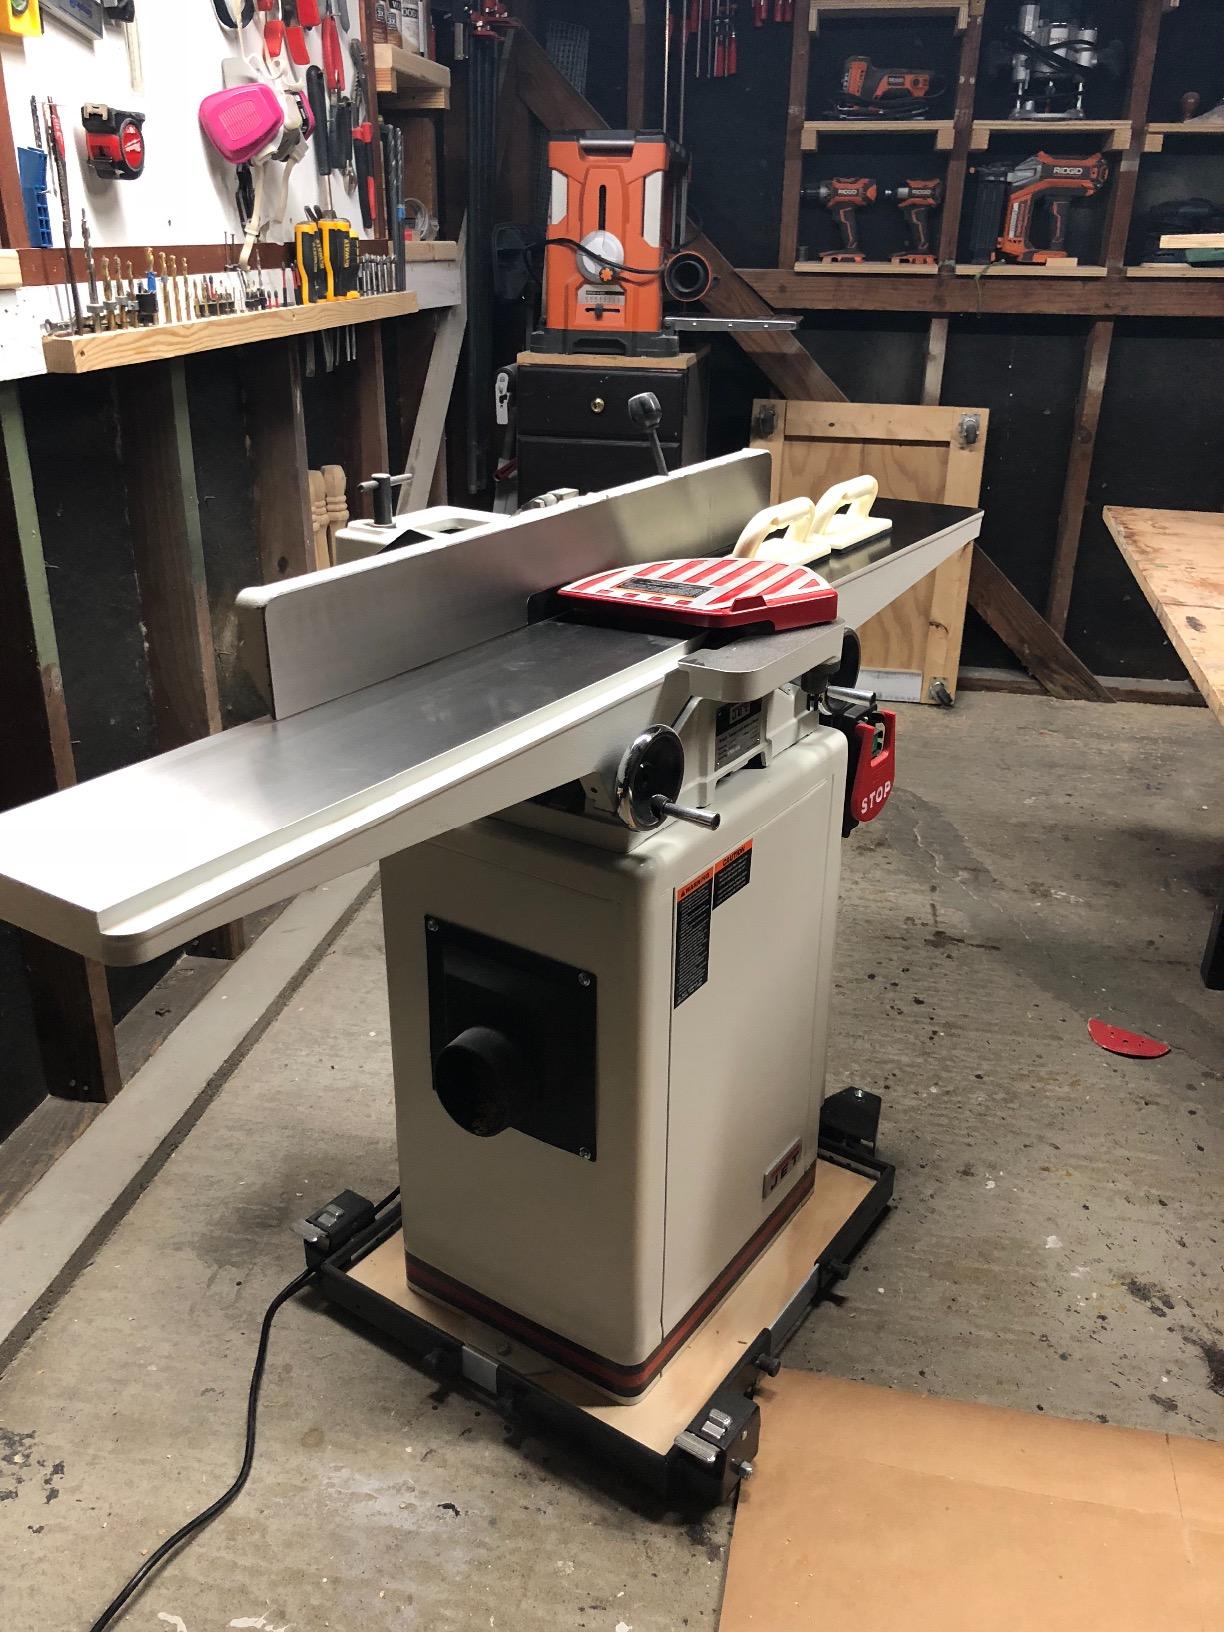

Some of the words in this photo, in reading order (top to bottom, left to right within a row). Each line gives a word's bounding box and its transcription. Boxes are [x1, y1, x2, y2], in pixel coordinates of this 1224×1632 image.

[1053, 166, 1083, 175] RIDGID
[860, 780, 891, 815] STOP
[722, 843, 746, 867] CAUTION
[685, 871, 710, 894] WARNING
[769, 1143, 801, 1192] JET
